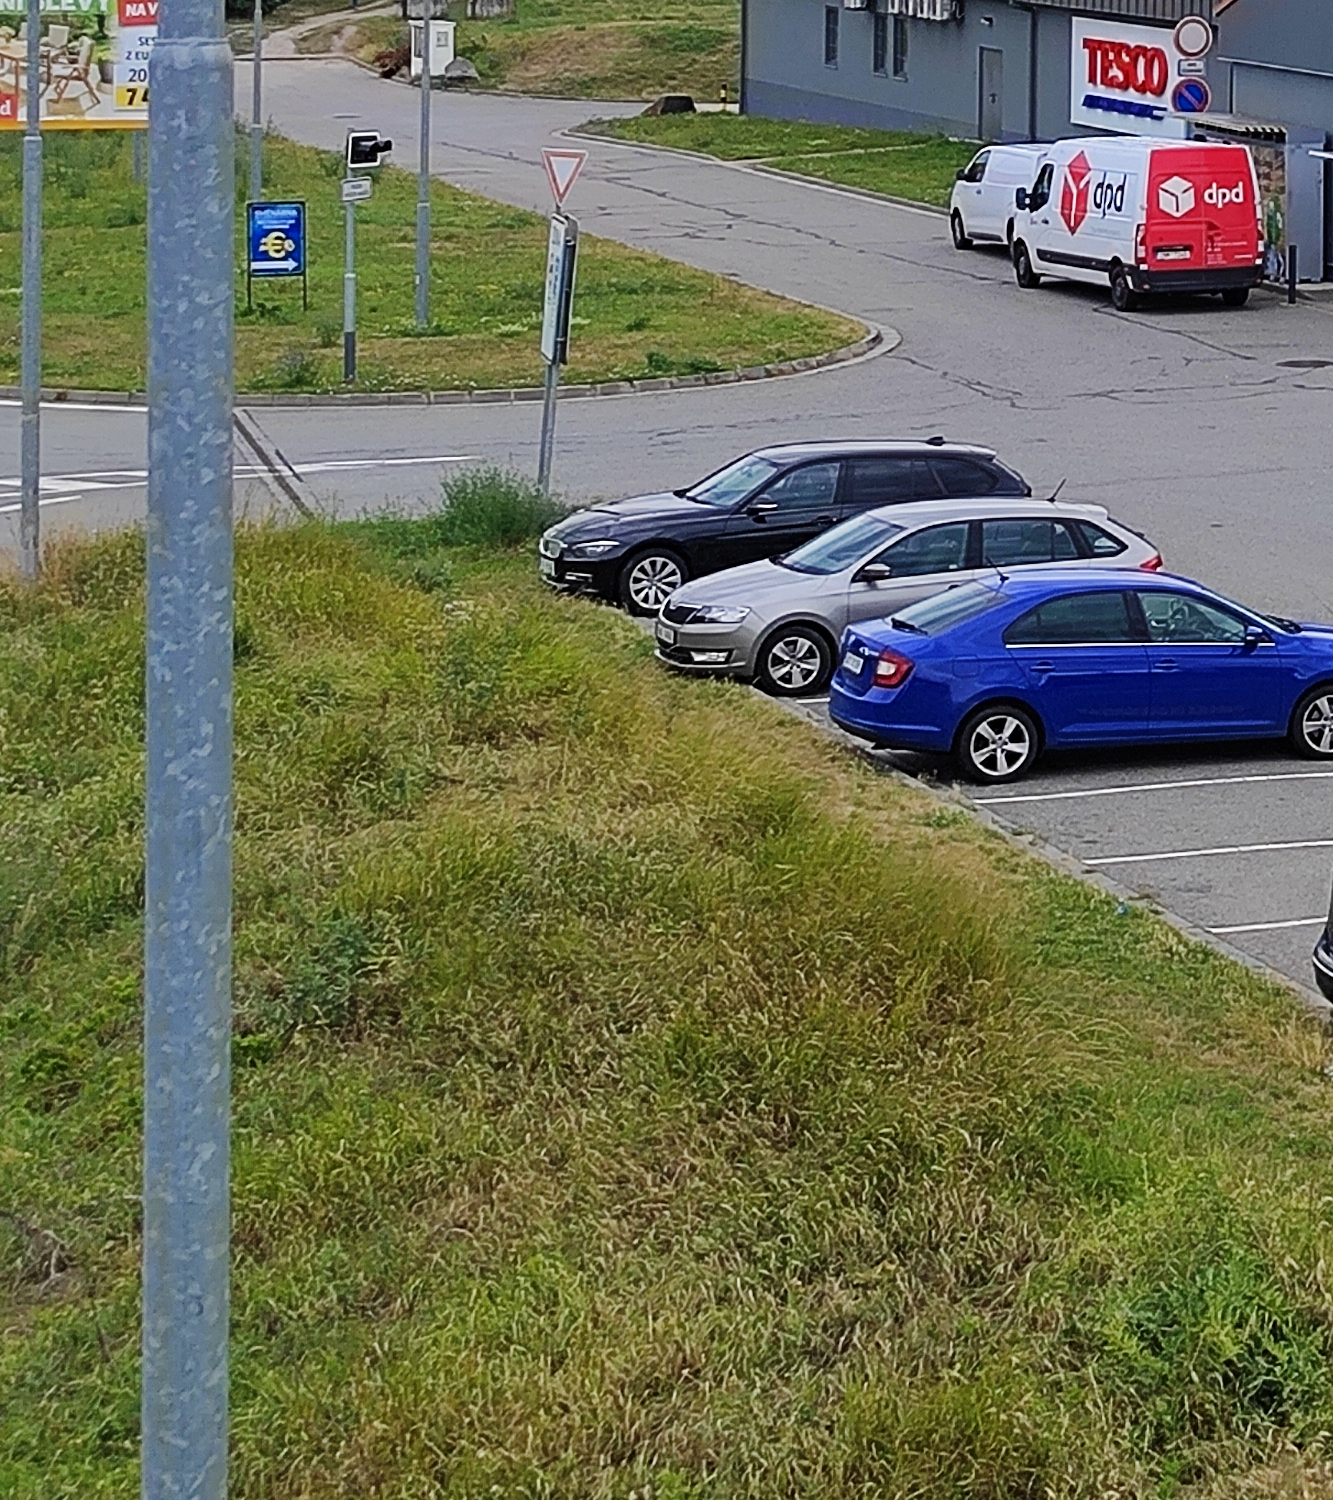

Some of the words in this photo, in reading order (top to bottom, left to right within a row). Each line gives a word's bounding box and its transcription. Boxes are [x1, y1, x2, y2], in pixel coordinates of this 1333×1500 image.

[126, 3, 146, 17] NA
[1082, 38, 1169, 97] TESCO
[1093, 171, 1127, 219] dpd
[1203, 181, 1244, 208] dpd
